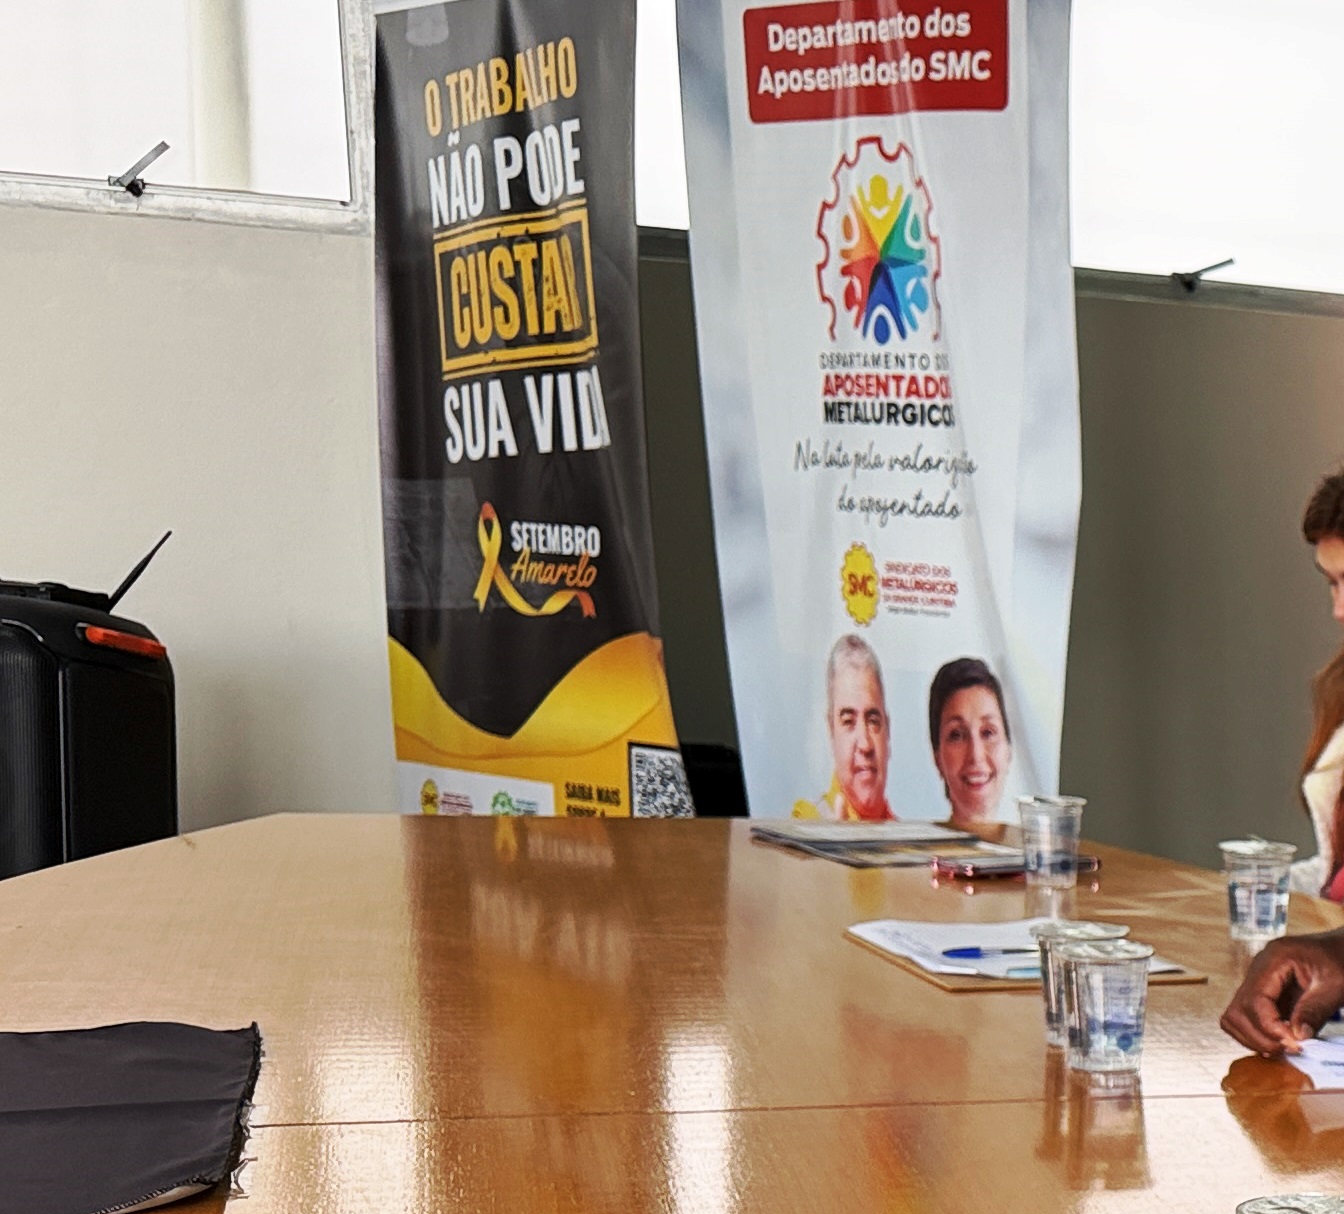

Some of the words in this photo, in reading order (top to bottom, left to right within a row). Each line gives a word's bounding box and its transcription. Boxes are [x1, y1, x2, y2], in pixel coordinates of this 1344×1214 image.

[767, 14, 921, 56] Departamento
[925, 7, 971, 39] dos
[424, 79, 442, 137] O
[445, 37, 578, 129] TRABALHO
[758, 56, 899, 99] Aposentados
[900, 53, 925, 81] do
[929, 50, 992, 81] SMC
[428, 130, 484, 229] NÃO
[494, 118, 585, 211] PODE
[820, 351, 930, 371] DEPARTAMENTO
[822, 373, 954, 400] APOSENTADO
[443, 378, 518, 464] SUA
[510, 520, 601, 558] SETEMBRO
[509, 547, 598, 588] Amarelo
